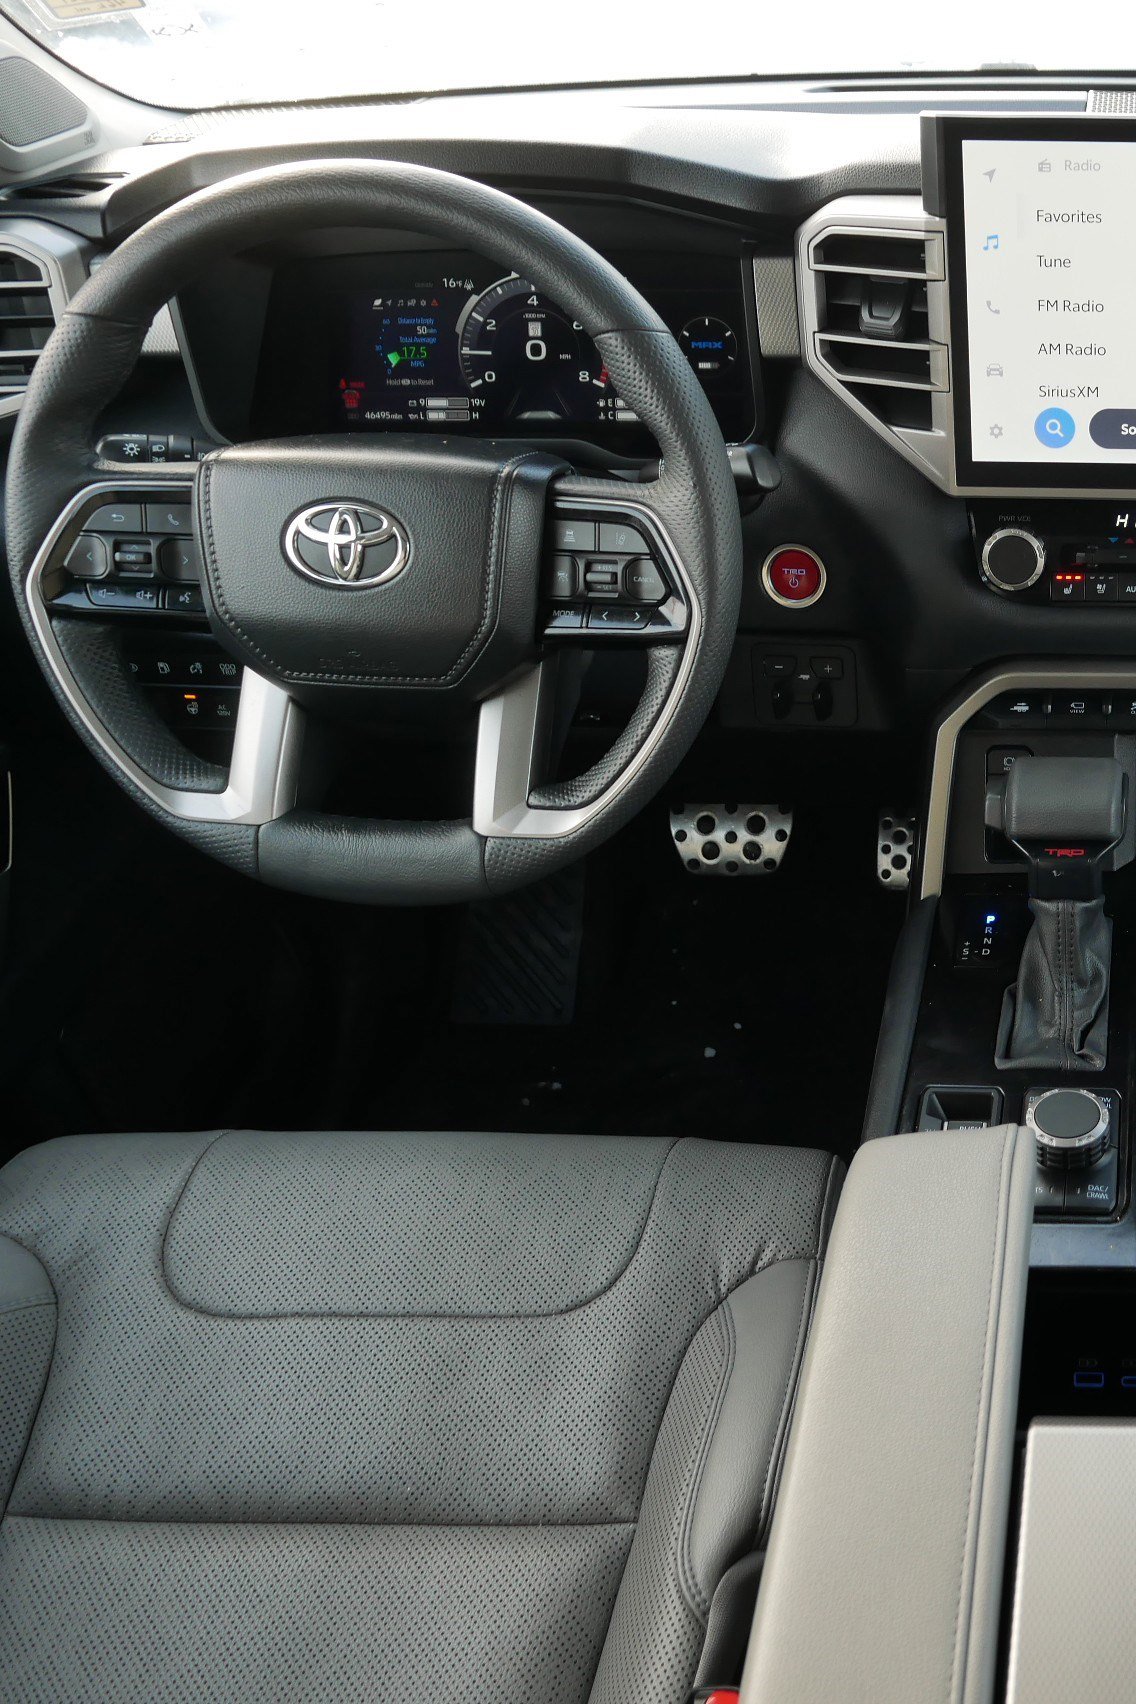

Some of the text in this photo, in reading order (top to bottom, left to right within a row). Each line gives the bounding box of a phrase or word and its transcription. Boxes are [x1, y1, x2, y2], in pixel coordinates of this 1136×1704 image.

[1064, 159, 1101, 172] Radio
[1036, 209, 1102, 224] Favorites
[1036, 254, 1072, 268] Tune
[527, 295, 539, 306] 4
[1038, 299, 1105, 313] FM Radio
[486, 319, 497, 331] 2
[526, 339, 547, 361] 0
[691, 341, 723, 349] MAX
[1038, 342, 1107, 356] AM Radio
[402, 346, 427, 359] 17.5
[386, 378, 400, 386] Hold
[418, 378, 434, 386] Reset
[484, 371, 496, 383] 0
[578, 371, 590, 382] 8
[1038, 384, 1100, 398] SiriusXM
[552, 609, 575, 617] MODE
[1044, 848, 1085, 857] TRD
[986, 915, 996, 924] P
[985, 926, 993, 934] R
[981, 948, 990, 956] D
